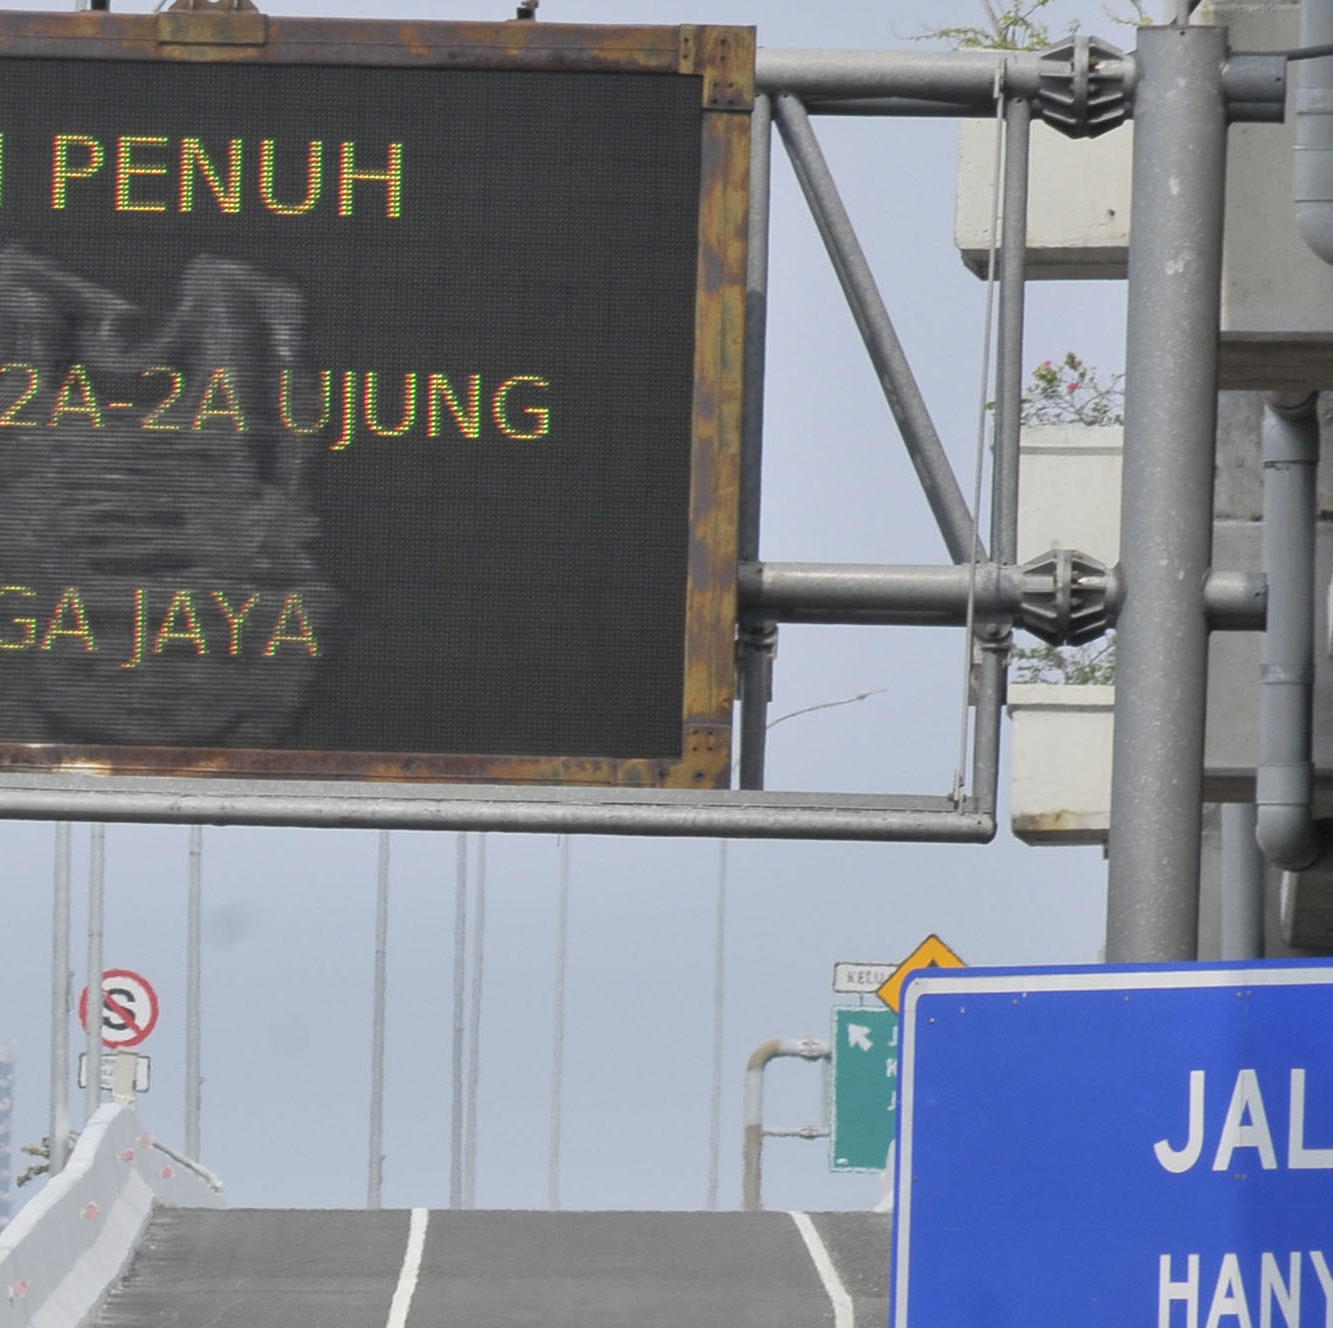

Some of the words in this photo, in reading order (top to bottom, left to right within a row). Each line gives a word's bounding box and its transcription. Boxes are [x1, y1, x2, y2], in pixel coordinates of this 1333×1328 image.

[52, 134, 406, 218] PENUH
[0, 362, 247, 434] 2A-2A
[279, 367, 551, 452] UJUNG
[121, 587, 319, 670] JAYA
